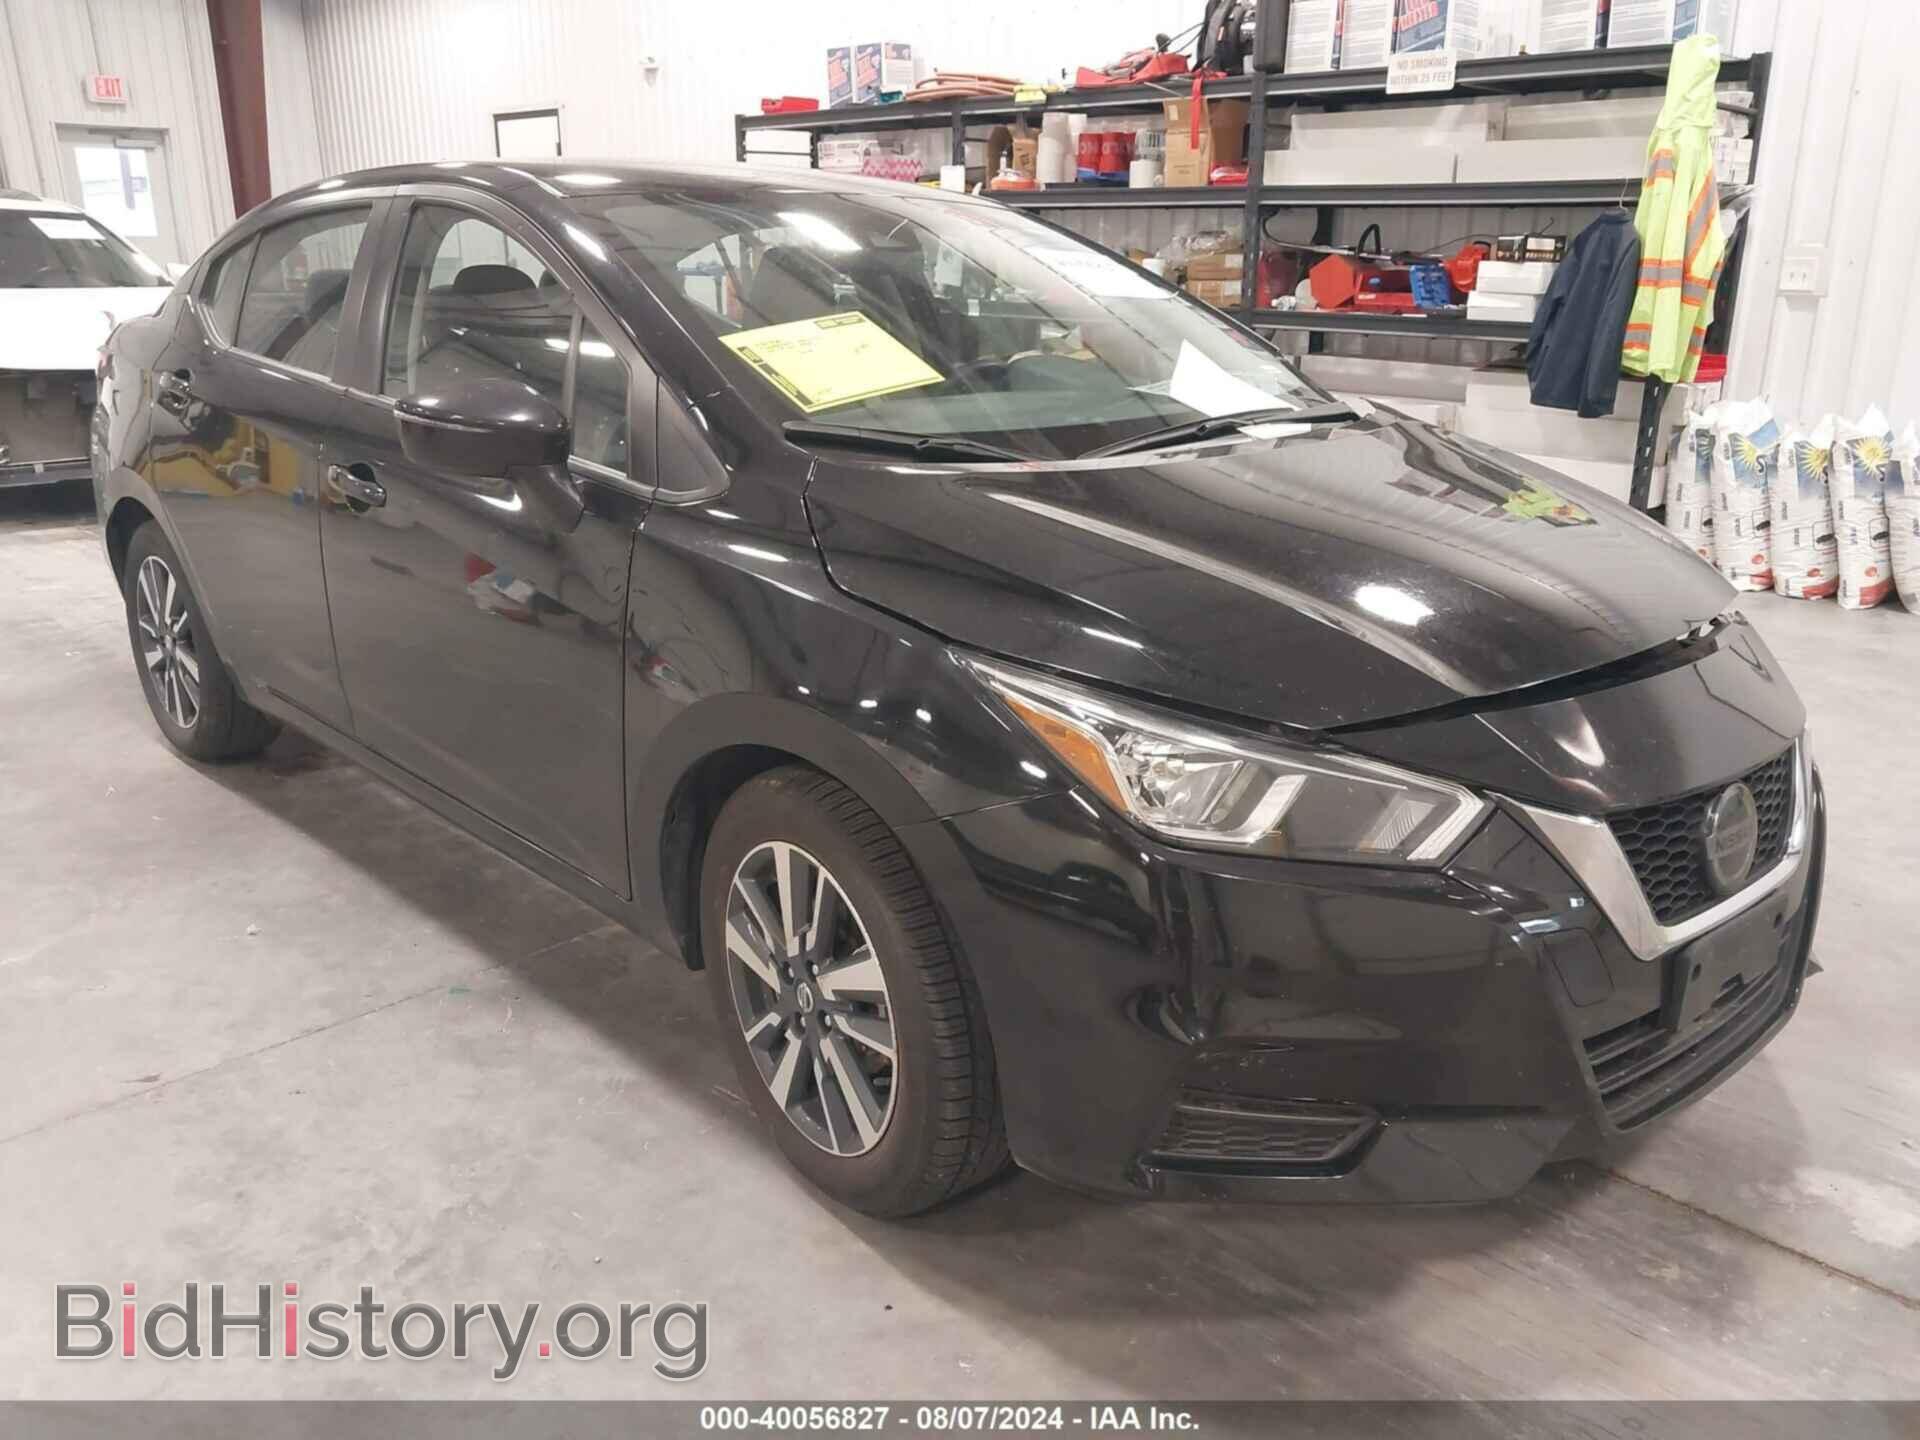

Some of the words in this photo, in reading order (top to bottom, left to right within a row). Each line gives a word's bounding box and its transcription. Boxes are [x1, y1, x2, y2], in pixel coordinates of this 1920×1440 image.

[1396, 59, 1409, 71] NO
[1411, 56, 1449, 70] SMOKING
[1432, 71, 1453, 83] FEET
[95, 77, 122, 97] EXIT
